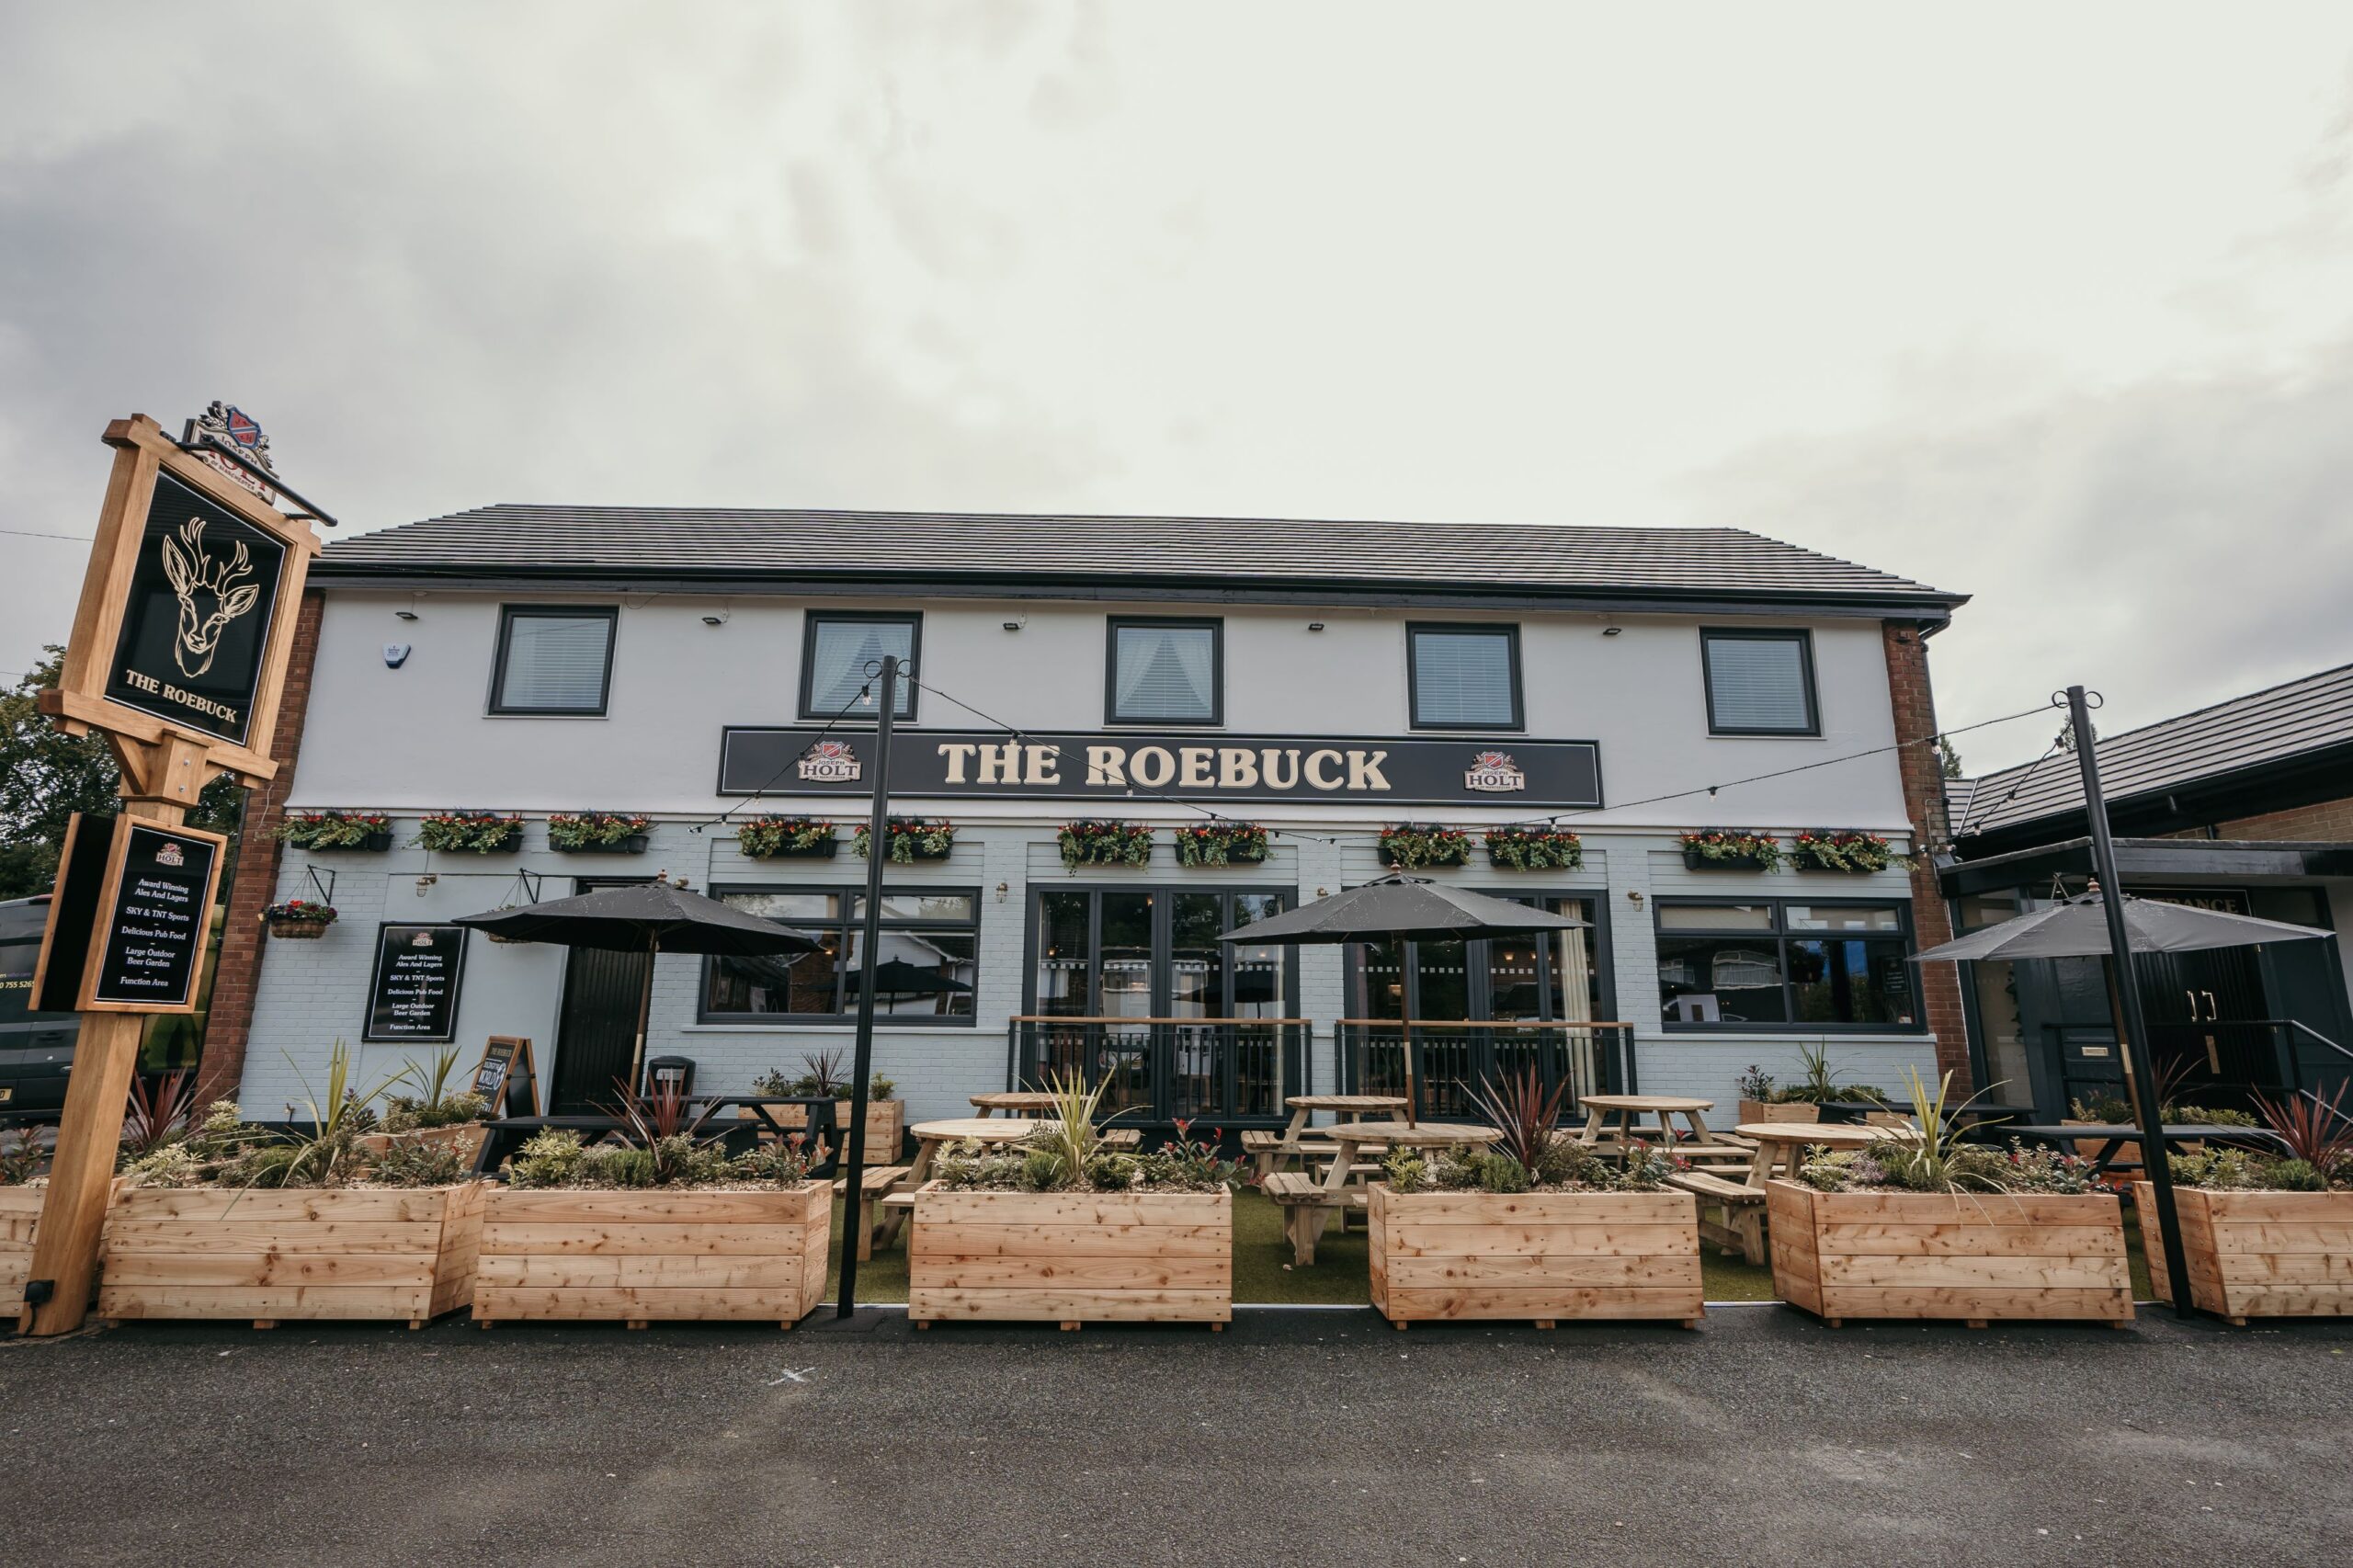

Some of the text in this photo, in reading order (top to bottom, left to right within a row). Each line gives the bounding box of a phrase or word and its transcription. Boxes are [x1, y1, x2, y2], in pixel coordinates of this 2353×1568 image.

[126, 669, 237, 722] THE ROEBUCK
[803, 765, 858, 776] HOLT
[938, 744, 1392, 791] THE ROEBUCK
[1469, 775, 1521, 786] HOLT
[158, 854, 183, 864] HOLT
[138, 878, 189, 894] Award Winning
[134, 888, 189, 903] Ales And Lagers
[126, 906, 190, 922] SKY & TNT Sports
[121, 926, 187, 940] Delicious Pub Food
[125, 946, 176, 959] Large Outdoor
[127, 957, 170, 968] Beer Garden
[119, 976, 168, 987] Function Area
